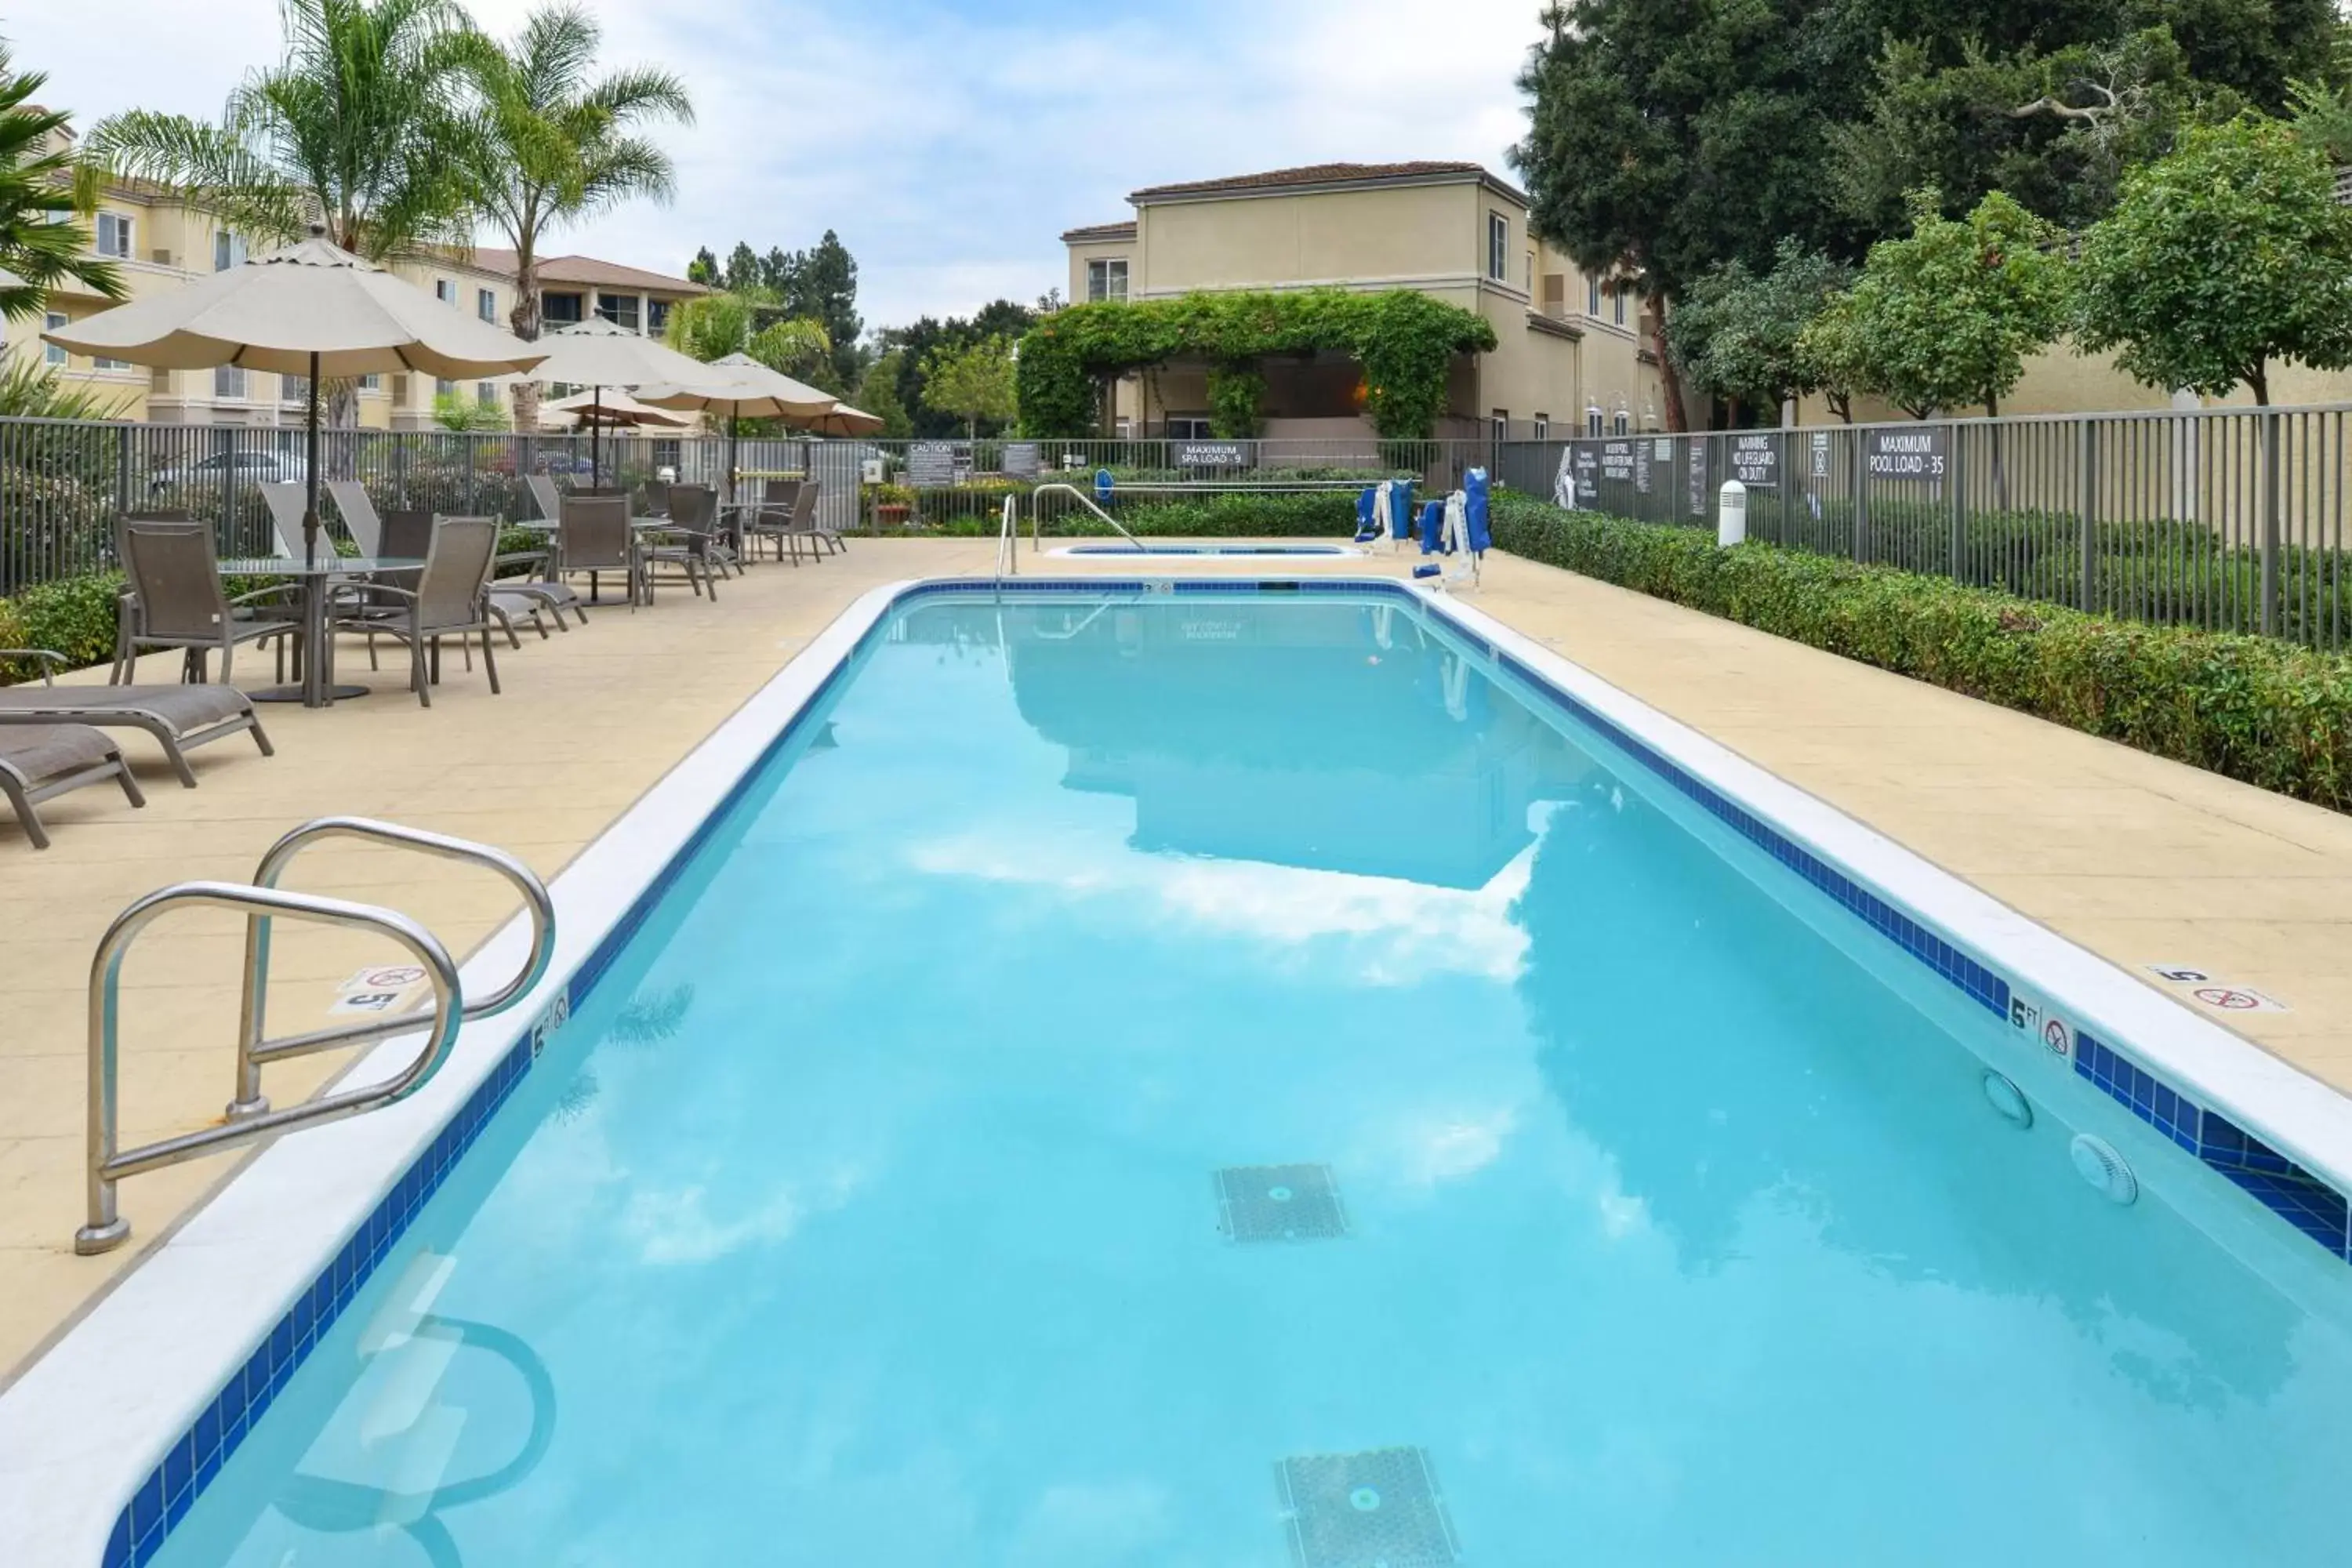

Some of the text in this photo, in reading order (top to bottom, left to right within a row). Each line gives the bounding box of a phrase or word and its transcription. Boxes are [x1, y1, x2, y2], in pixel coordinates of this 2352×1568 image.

[910, 443, 951, 452] CAUTION
[1880, 435, 1932, 452] MAXIMUM
[1186, 445, 1236, 454] MAXIMUM
[1181, 454, 1199, 463] SPA
[1200, 454, 1227, 463] LOAD
[1235, 454, 1241, 463] 9
[1870, 455, 1893, 472] POOL
[1895, 456, 1922, 473] LOAD
[1931, 456, 1944, 474] 35
[1738, 466, 1767, 480] ON DUTY
